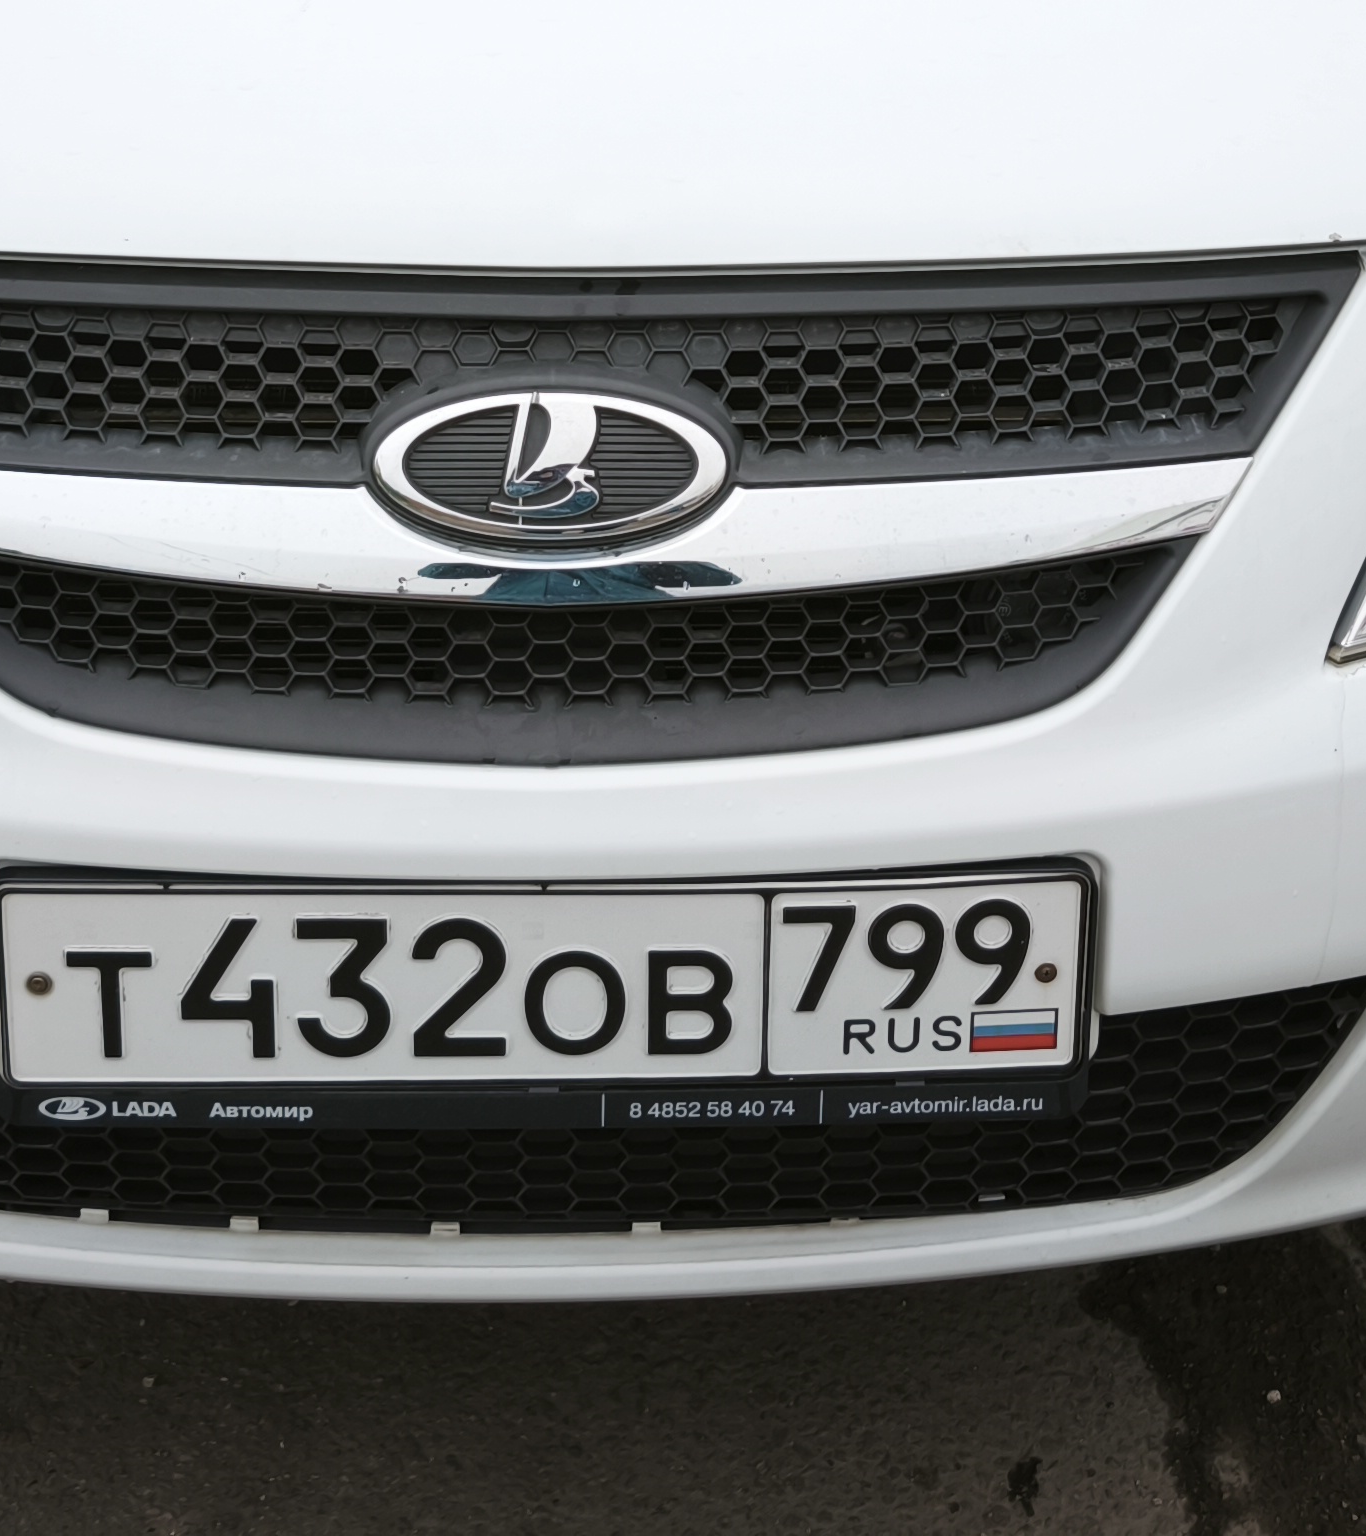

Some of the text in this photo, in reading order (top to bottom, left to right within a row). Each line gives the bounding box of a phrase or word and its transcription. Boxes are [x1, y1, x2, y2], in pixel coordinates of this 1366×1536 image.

[65, 898, 1031, 1058] Т432ОВ 799
[842, 1015, 963, 1055] RUS
[112, 1101, 177, 1117] LADA
[209, 1102, 313, 1121] Автомир
[629, 1100, 795, 1118] 8 4852 58 40 74
[848, 1095, 1043, 1118] yar-avtomir.lada.ru
